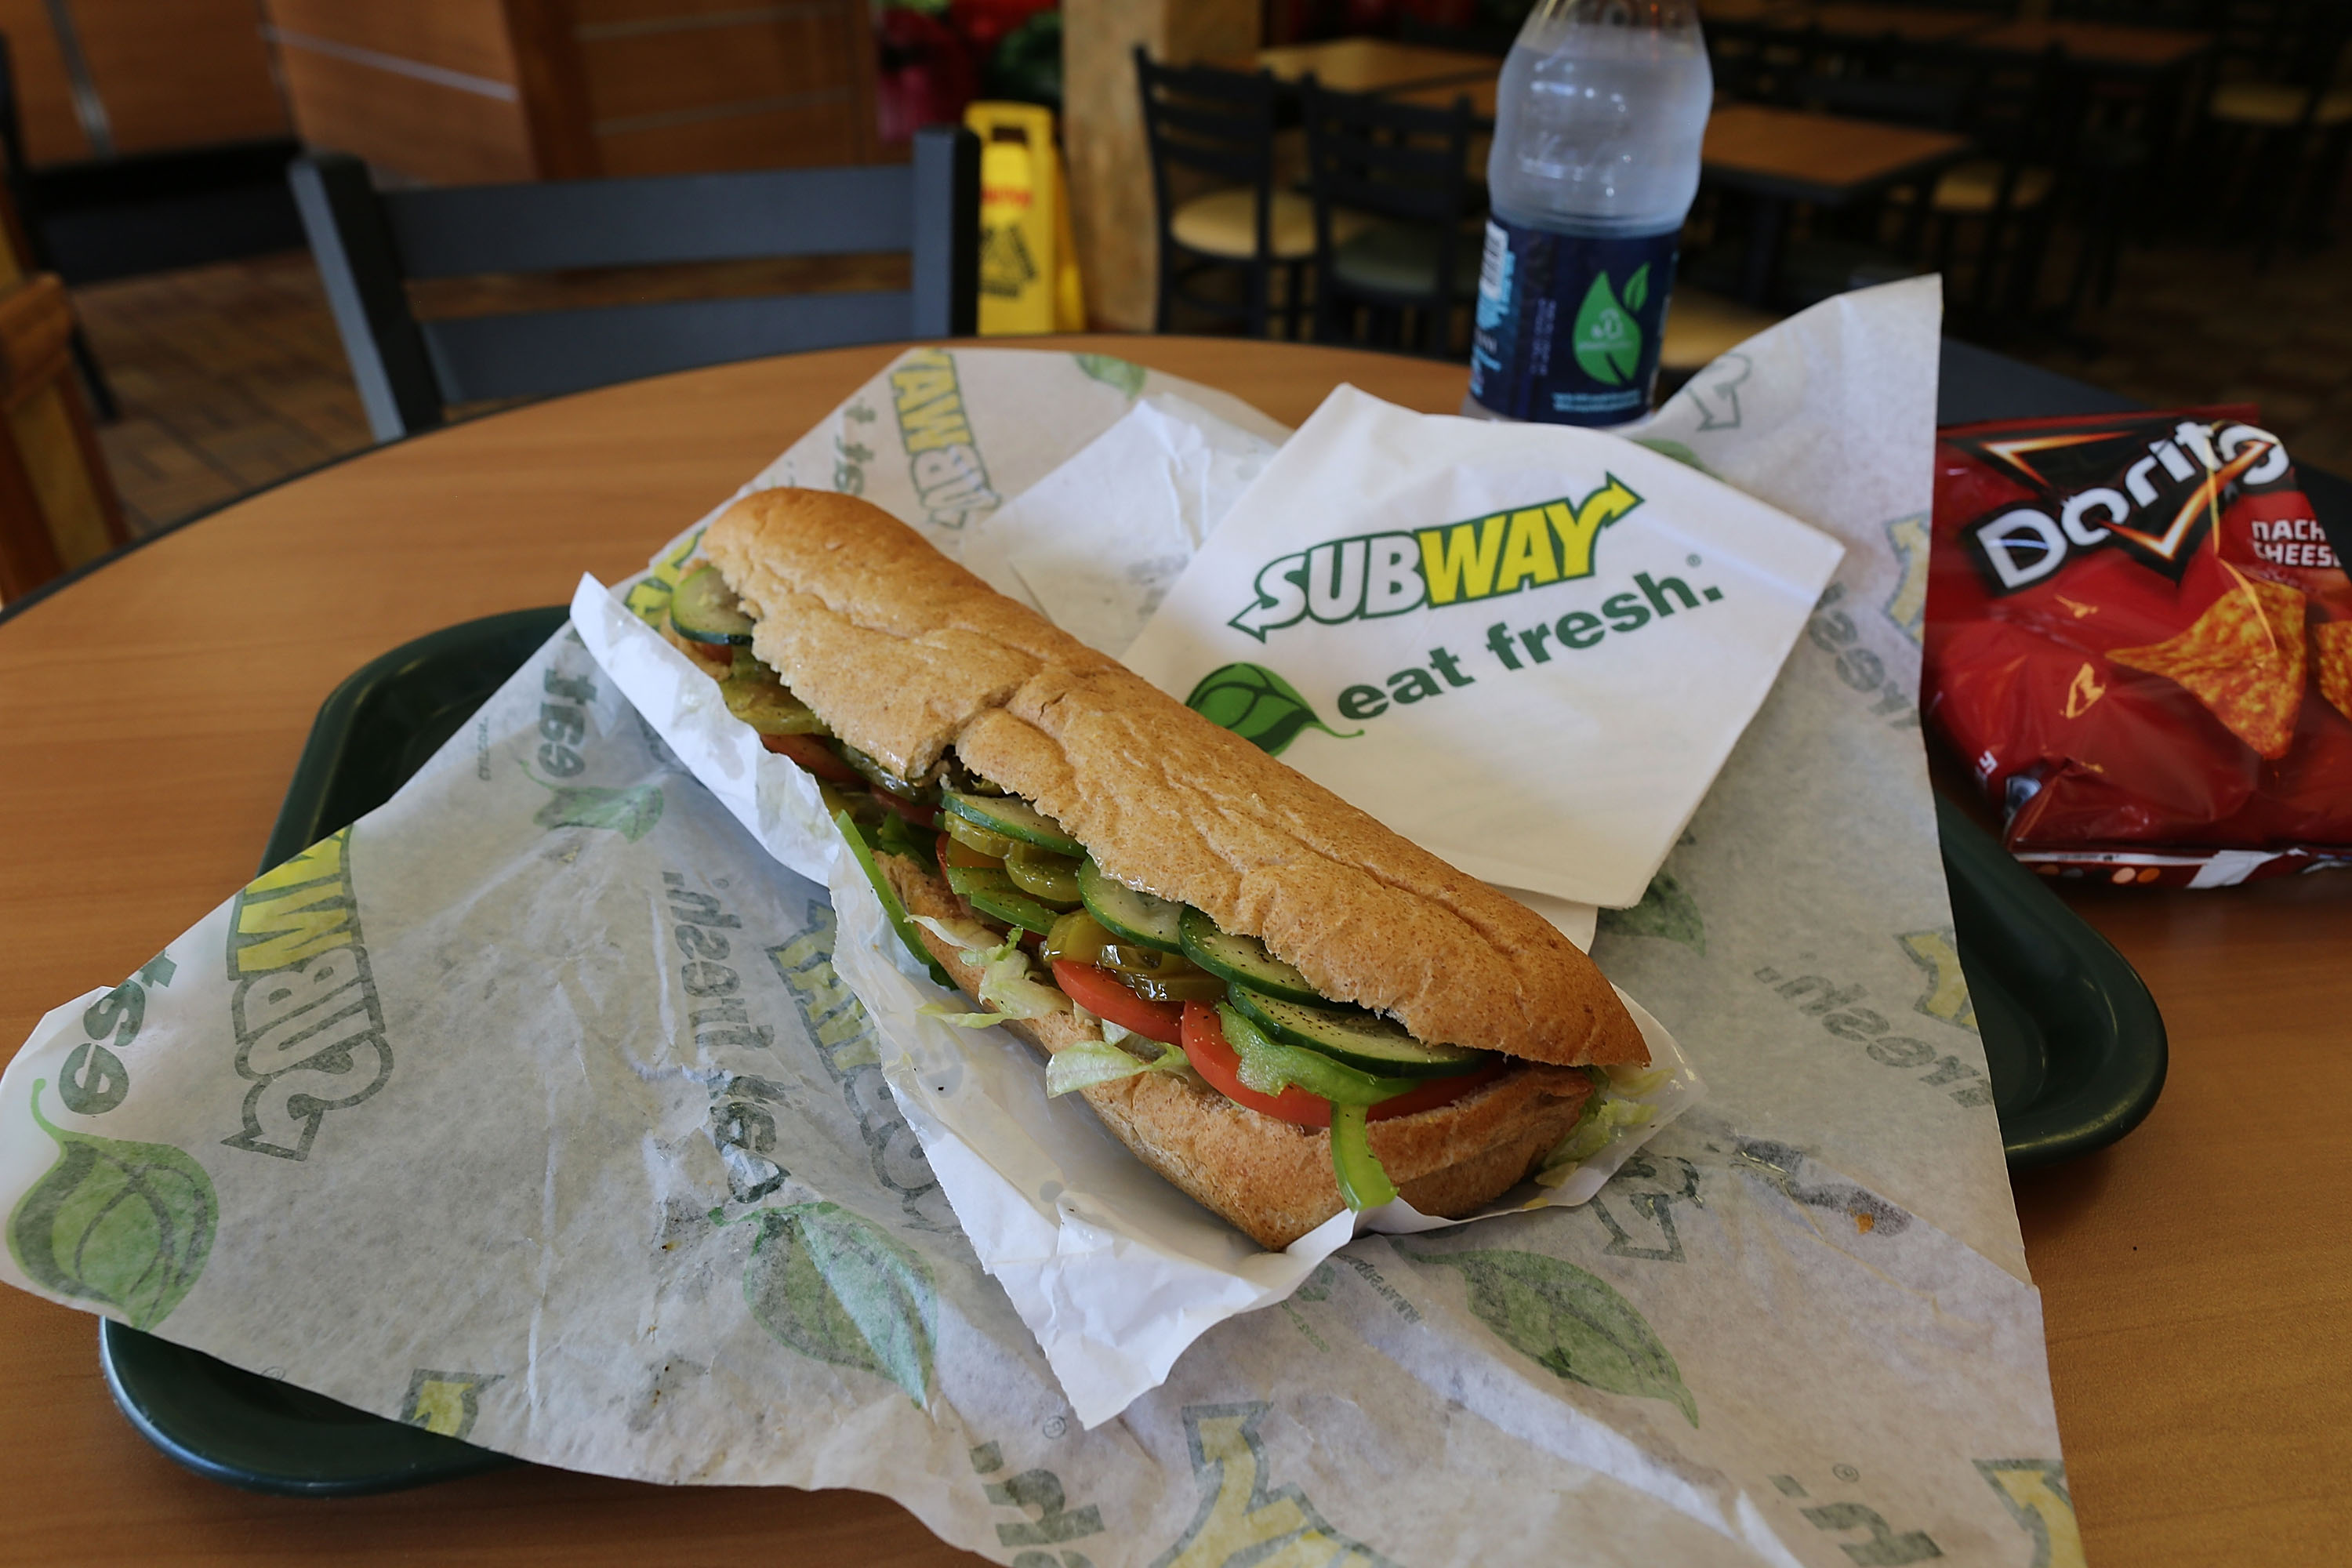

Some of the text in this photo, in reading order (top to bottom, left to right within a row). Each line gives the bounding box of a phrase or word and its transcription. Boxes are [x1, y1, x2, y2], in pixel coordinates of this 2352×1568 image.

[1228, 470, 1644, 643] SUBWAY
[1976, 420, 2290, 590] Doritos
[2252, 540, 2342, 567] CHEES
[1336, 571, 1724, 720] eat fresh.
